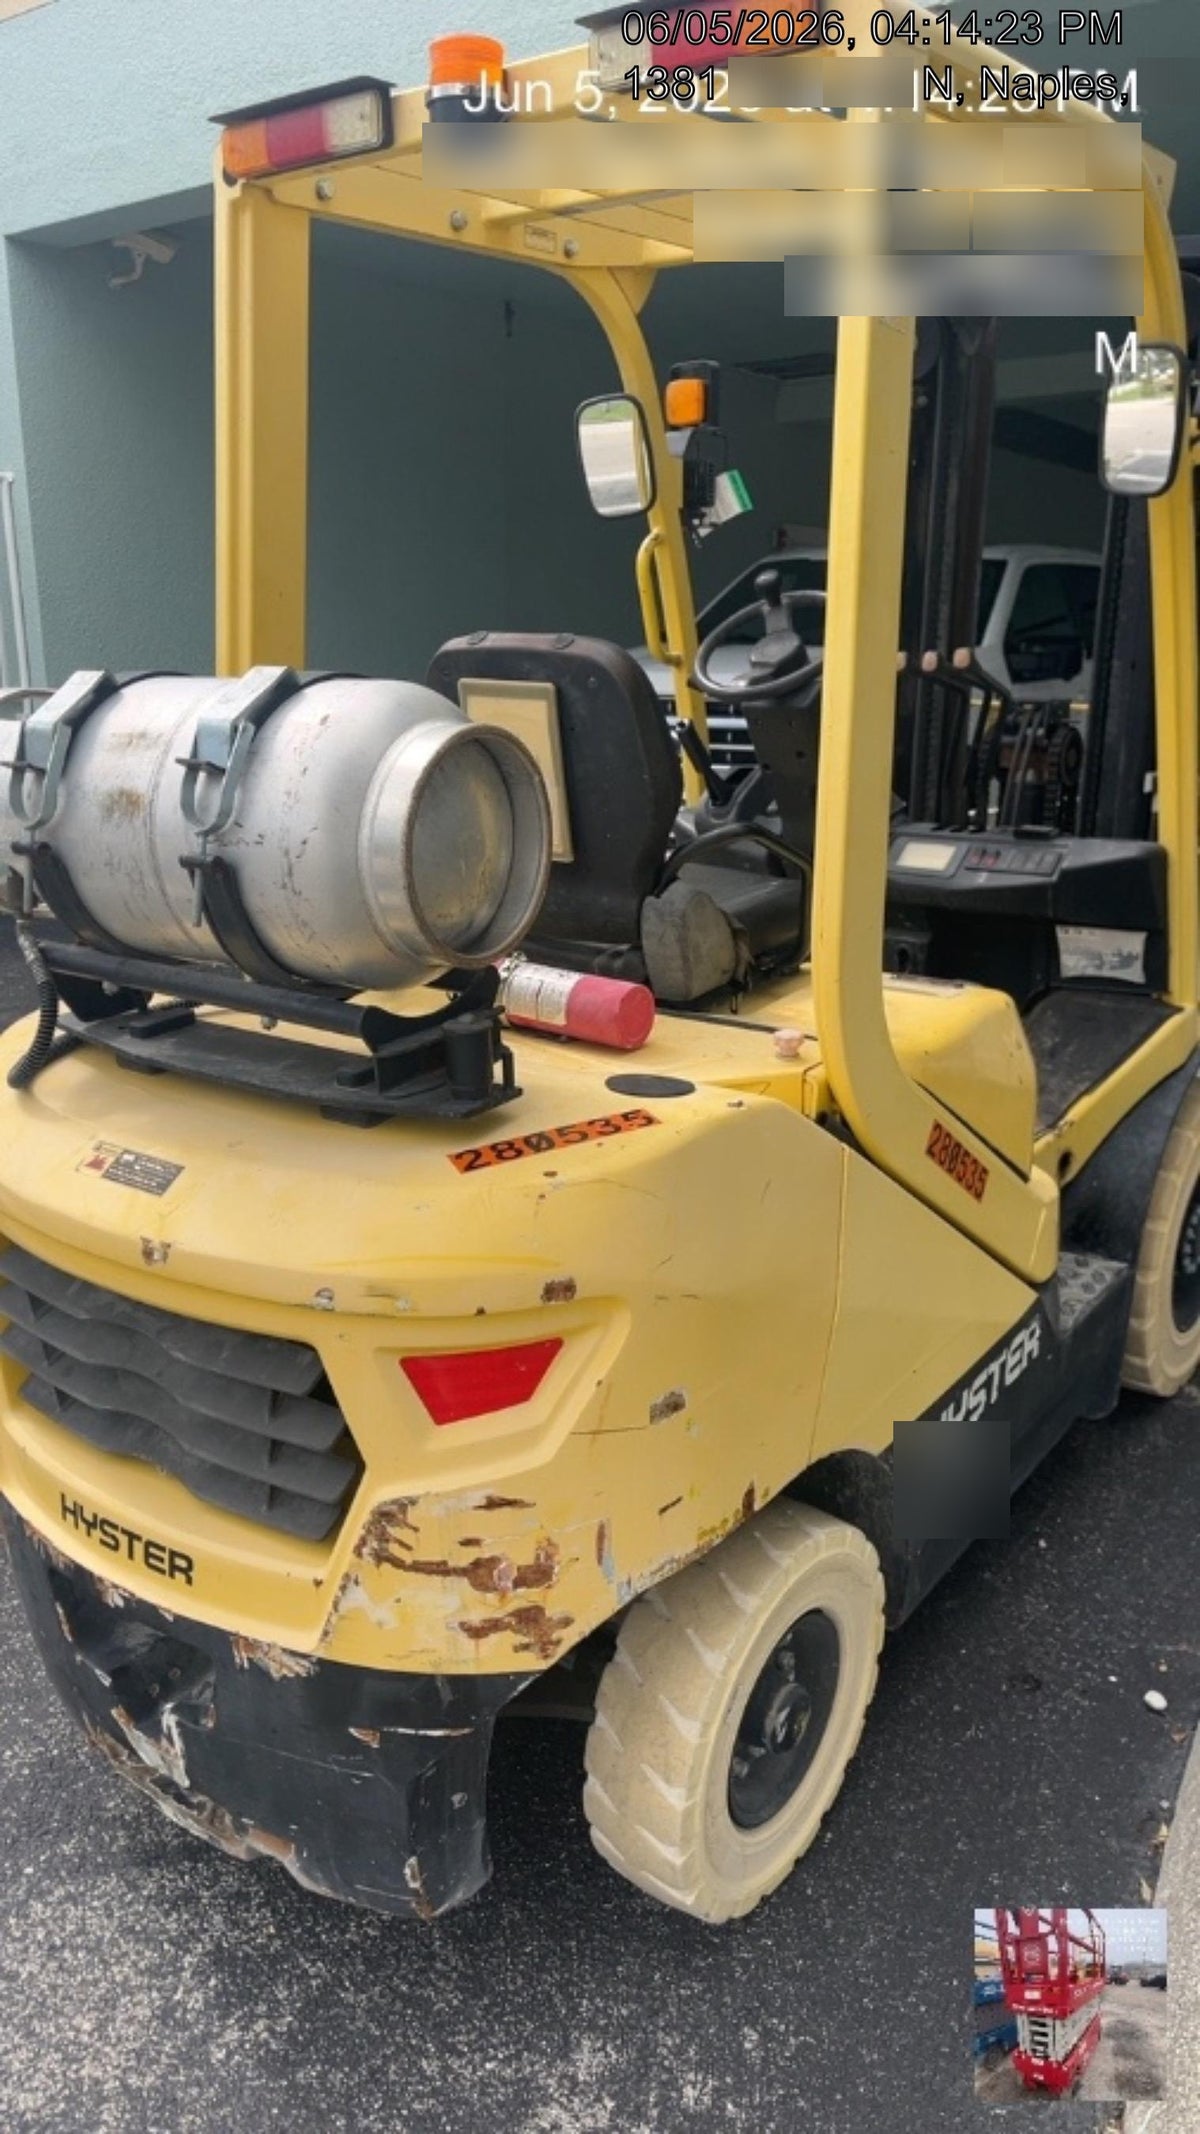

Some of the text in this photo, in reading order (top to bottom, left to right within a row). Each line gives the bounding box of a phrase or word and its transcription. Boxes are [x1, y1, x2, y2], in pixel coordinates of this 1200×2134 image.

[454, 1108, 656, 1172] 280535
[926, 1121, 988, 1201] 280535
[941, 1313, 1041, 1421] YSTER
[60, 1492, 194, 1586] HYSTER
